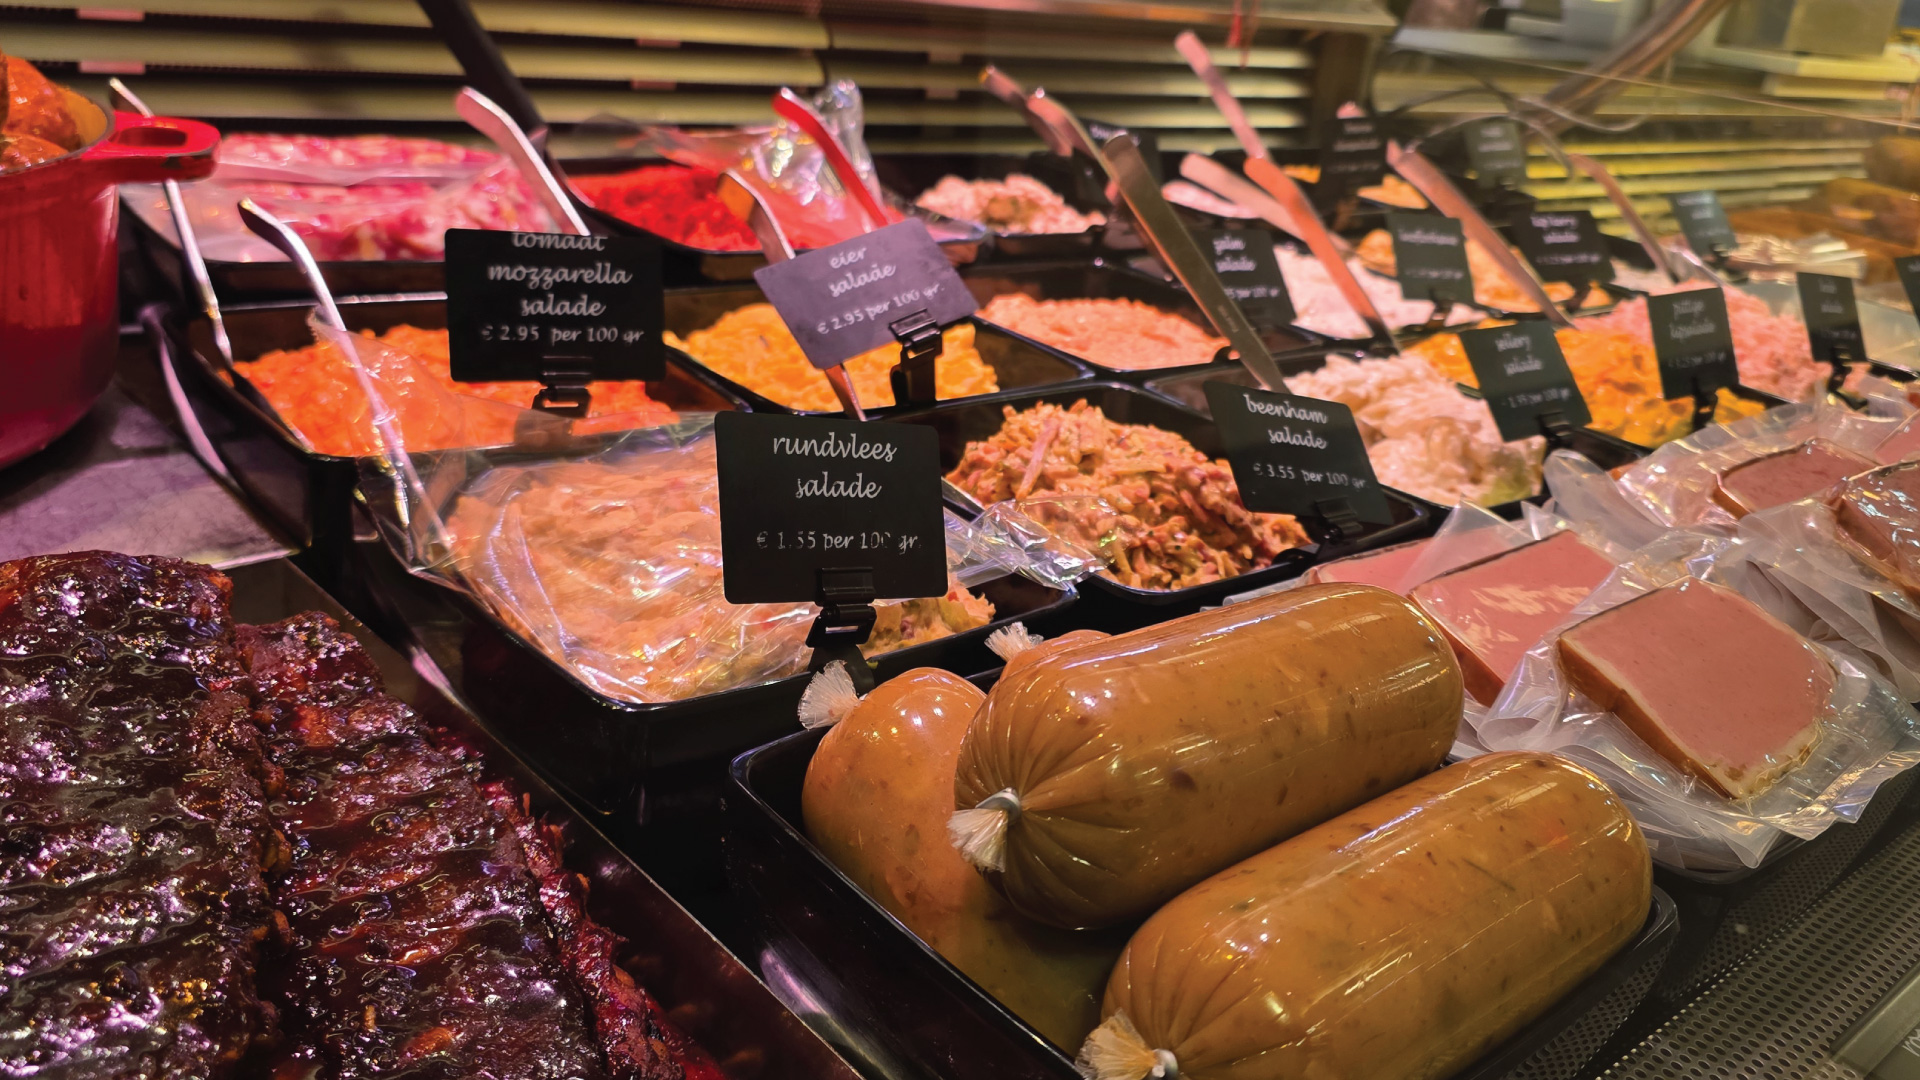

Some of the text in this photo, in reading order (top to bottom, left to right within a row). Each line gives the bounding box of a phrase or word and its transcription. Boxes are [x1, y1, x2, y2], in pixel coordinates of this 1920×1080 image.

[511, 232, 608, 252] tomaat
[829, 247, 867, 269] eier
[487, 263, 633, 290] mozzarella
[828, 264, 896, 297] salade
[520, 294, 607, 317] salade
[816, 321, 830, 335] €
[831, 308, 865, 331] 2.95
[866, 299, 891, 321] per
[895, 289, 921, 308] 100
[500, 325, 540, 342] 2.95
[552, 327, 581, 347] per
[588, 326, 619, 343] 100
[1243, 393, 1328, 424] beenham
[773, 431, 897, 462] rundvlees
[1268, 426, 1328, 450] salade
[795, 471, 882, 499] salade
[1266, 463, 1296, 480] 3.55
[1301, 469, 1323, 486] per
[1326, 471, 1349, 487] 100
[756, 530, 769, 549] €
[823, 532, 854, 551] per
